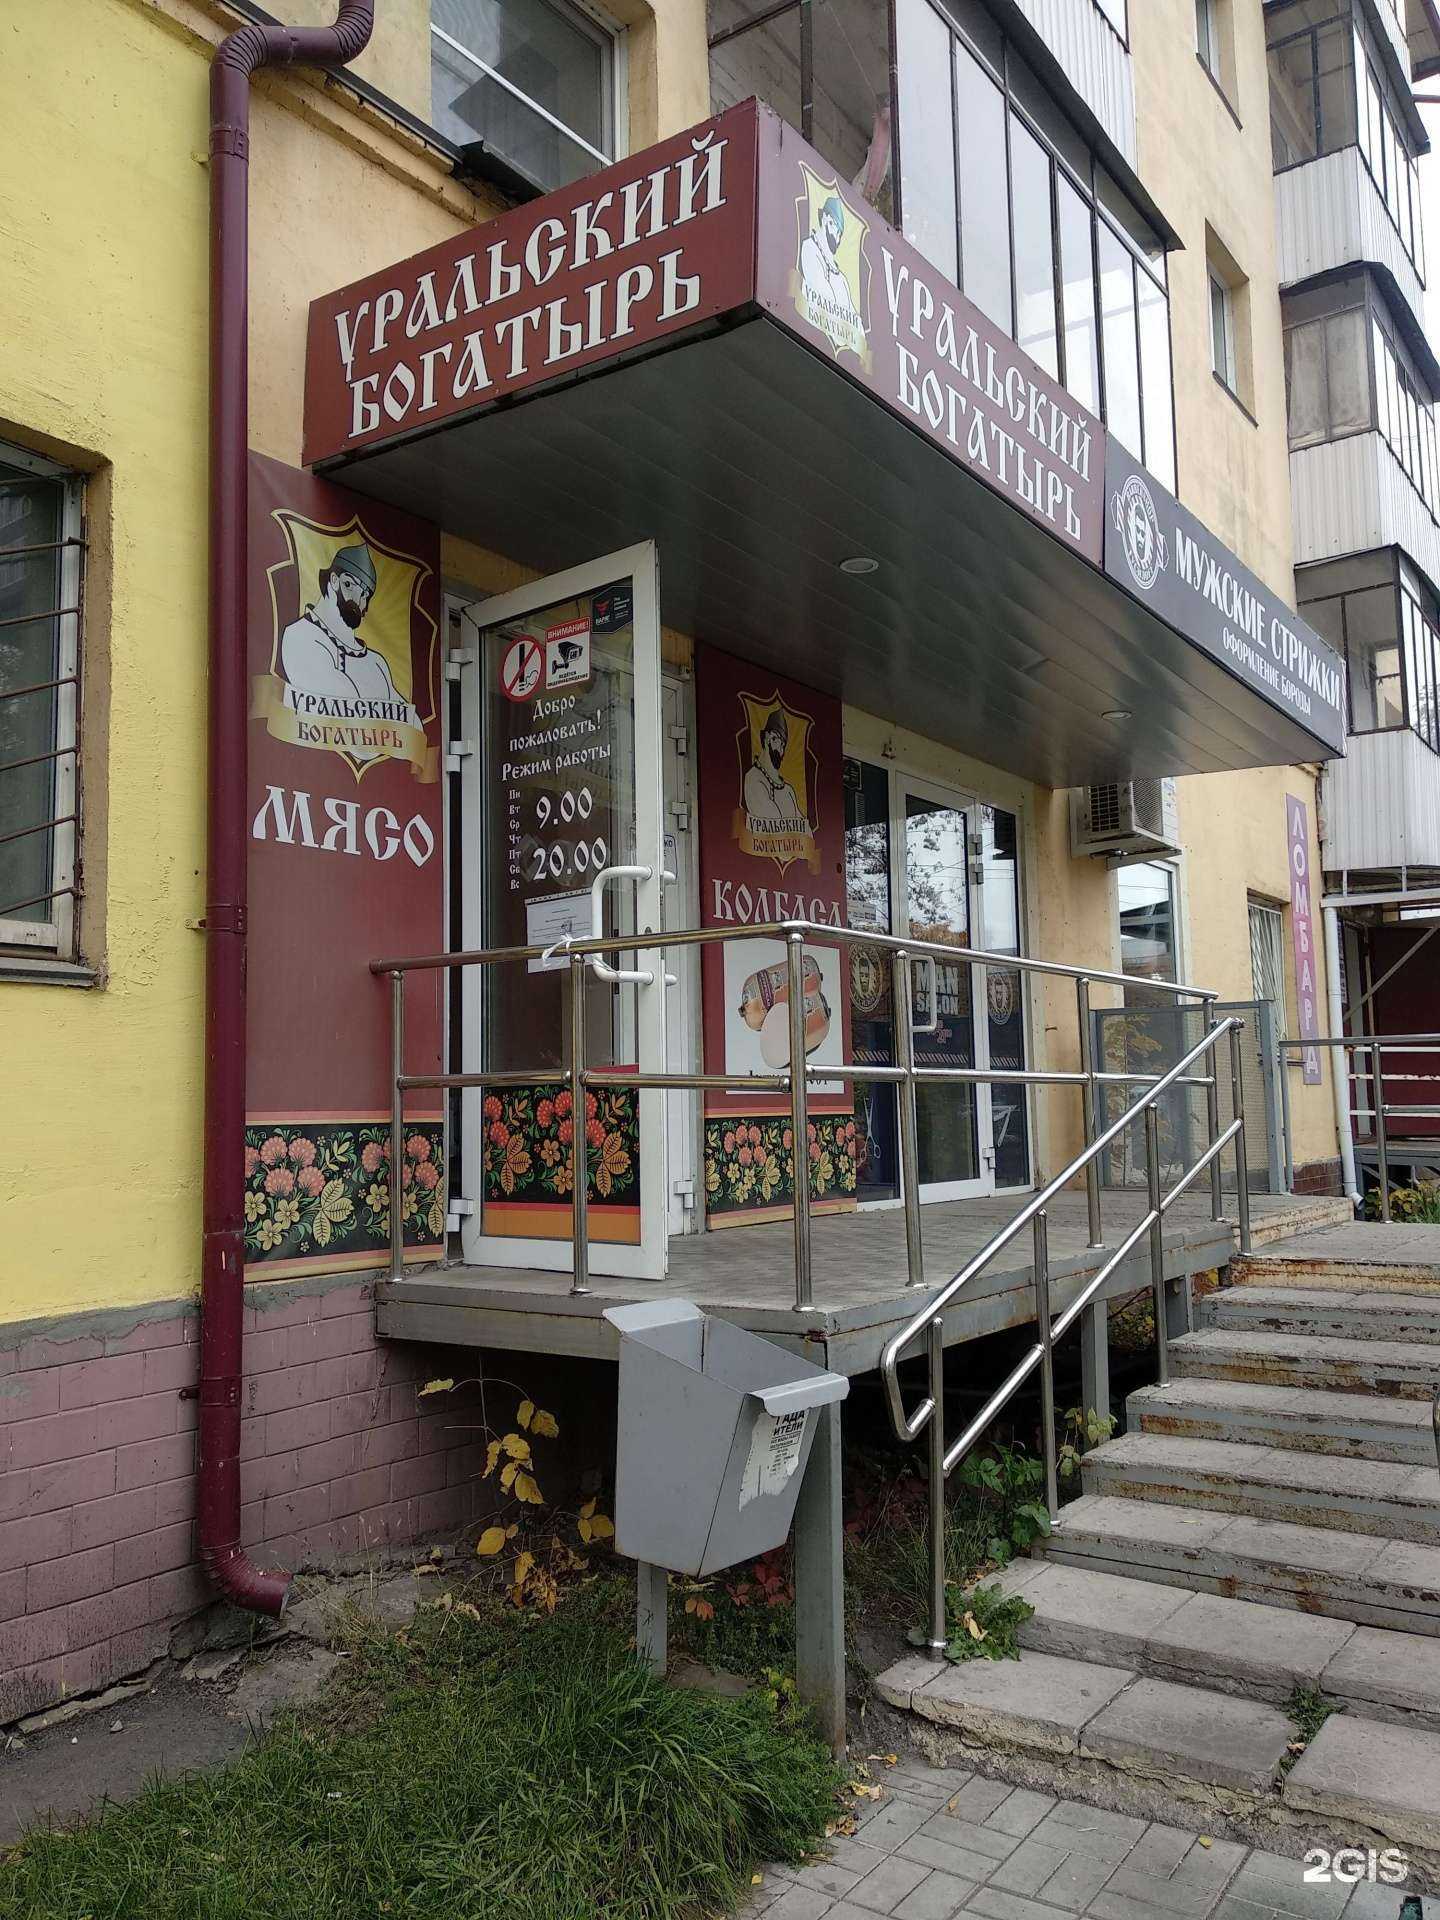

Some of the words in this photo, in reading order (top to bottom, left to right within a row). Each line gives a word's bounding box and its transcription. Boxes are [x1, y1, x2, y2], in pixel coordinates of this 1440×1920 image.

[335, 129, 729, 383] УРАЛЬСКИЙ
[805, 284, 859, 328] УРАЛЬСКИЙ
[808, 307, 857, 345] БОГАТЫРЬ
[349, 249, 700, 439] БОГАТЫРЬ
[881, 246, 1092, 483] УРАЛЬСКИЙ
[896, 342, 1082, 541] БОГАТЫРЬ
[547, 620, 589, 639] ВНИМАНИЕ!
[1175, 527, 1267, 648] МУЖСКИЕ
[1271, 618, 1341, 711] СТРИЖКИ
[1222, 627, 1281, 692] ОФОРМЛЕНИЕ
[1281, 674, 1312, 716] БОРОДЫ
[290, 690, 410, 724] УРАЛЬСКИЙ
[533, 695, 575, 722] Добро
[297, 721, 403, 749] БОГАТЫРЬ
[509, 709, 601, 751] пожаловать!
[502, 759, 551, 781] Режим
[555, 744, 610, 775] работы
[252, 784, 435, 868] МЯСО
[536, 786, 593, 830] 9.00
[748, 815, 806, 834] УРАЛЬСКИЙ
[532, 836, 607, 881] 20.00
[752, 837, 805, 853] БОГАТЫРЬ
[711, 879, 842, 927] КОЛБАСА
[1291, 805, 1319, 1075] ЛОМБАРД
